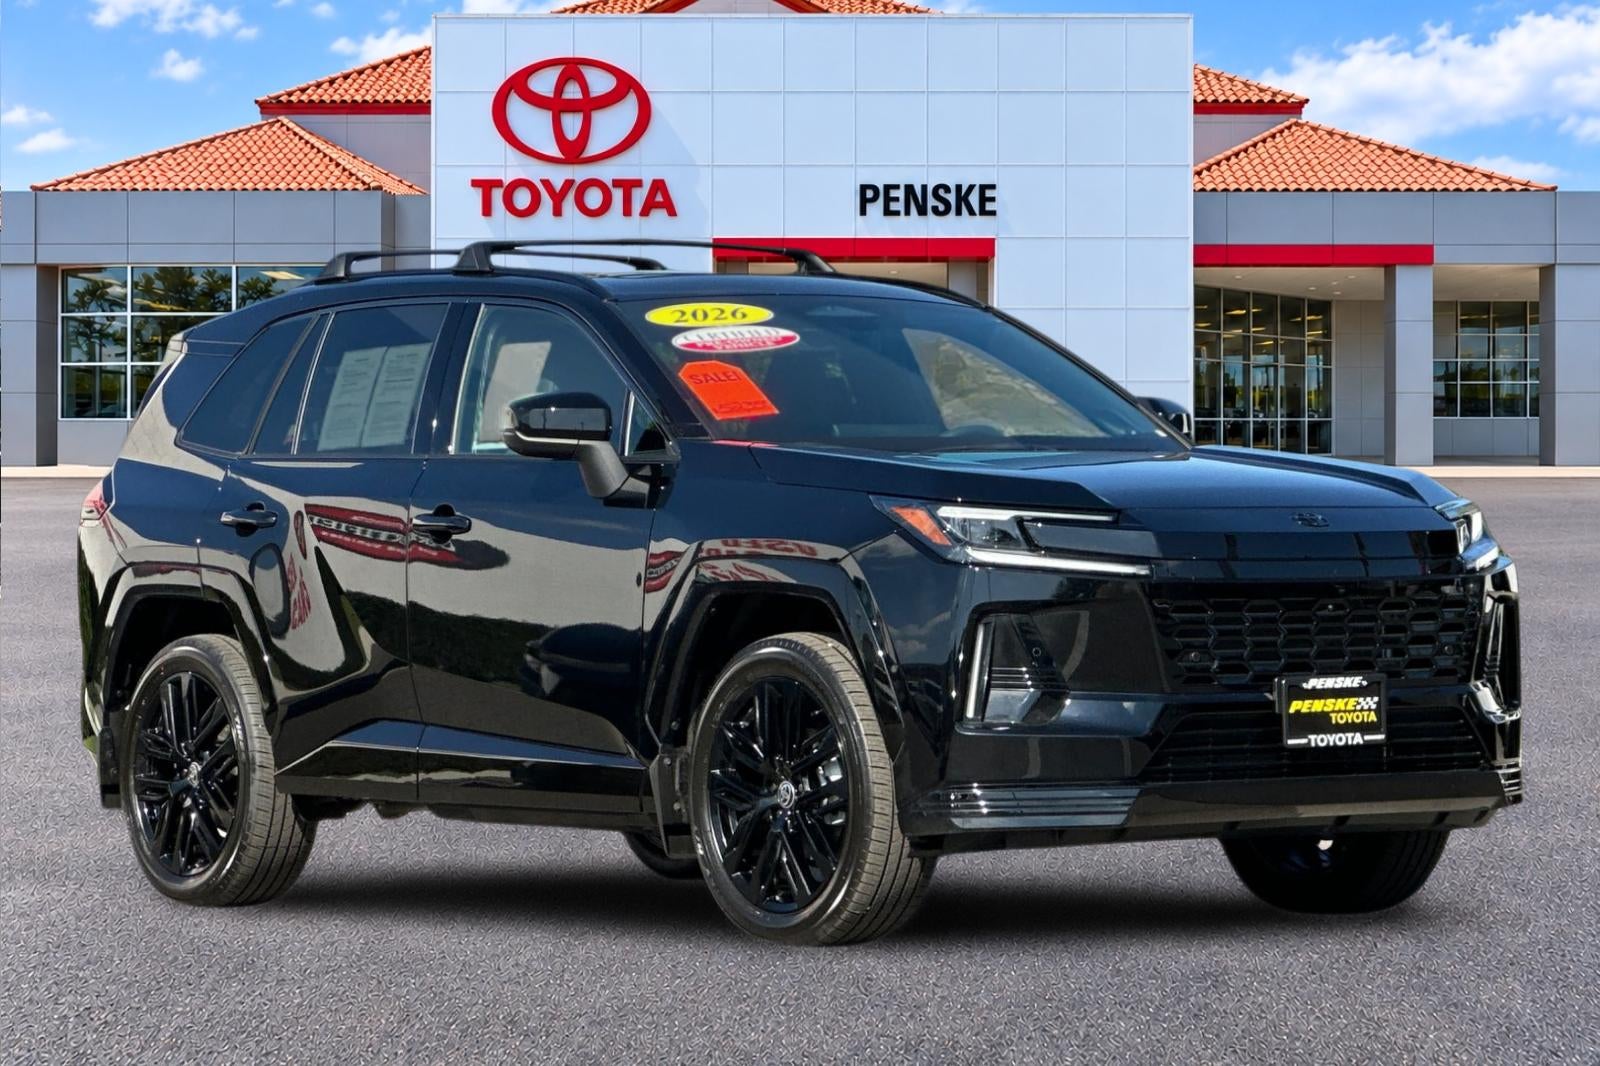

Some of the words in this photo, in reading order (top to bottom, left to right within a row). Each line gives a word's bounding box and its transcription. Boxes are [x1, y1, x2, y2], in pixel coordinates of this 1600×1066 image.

[471, 178, 676, 217] TOYOTA
[860, 184, 996, 216] PENSKE
[670, 307, 747, 323] 2026
[1308, 676, 1363, 689] PENSKE
[1289, 697, 1358, 713] PENSKE
[1329, 710, 1377, 724] TOYOTA
[1308, 733, 1363, 746] TOYOTA
